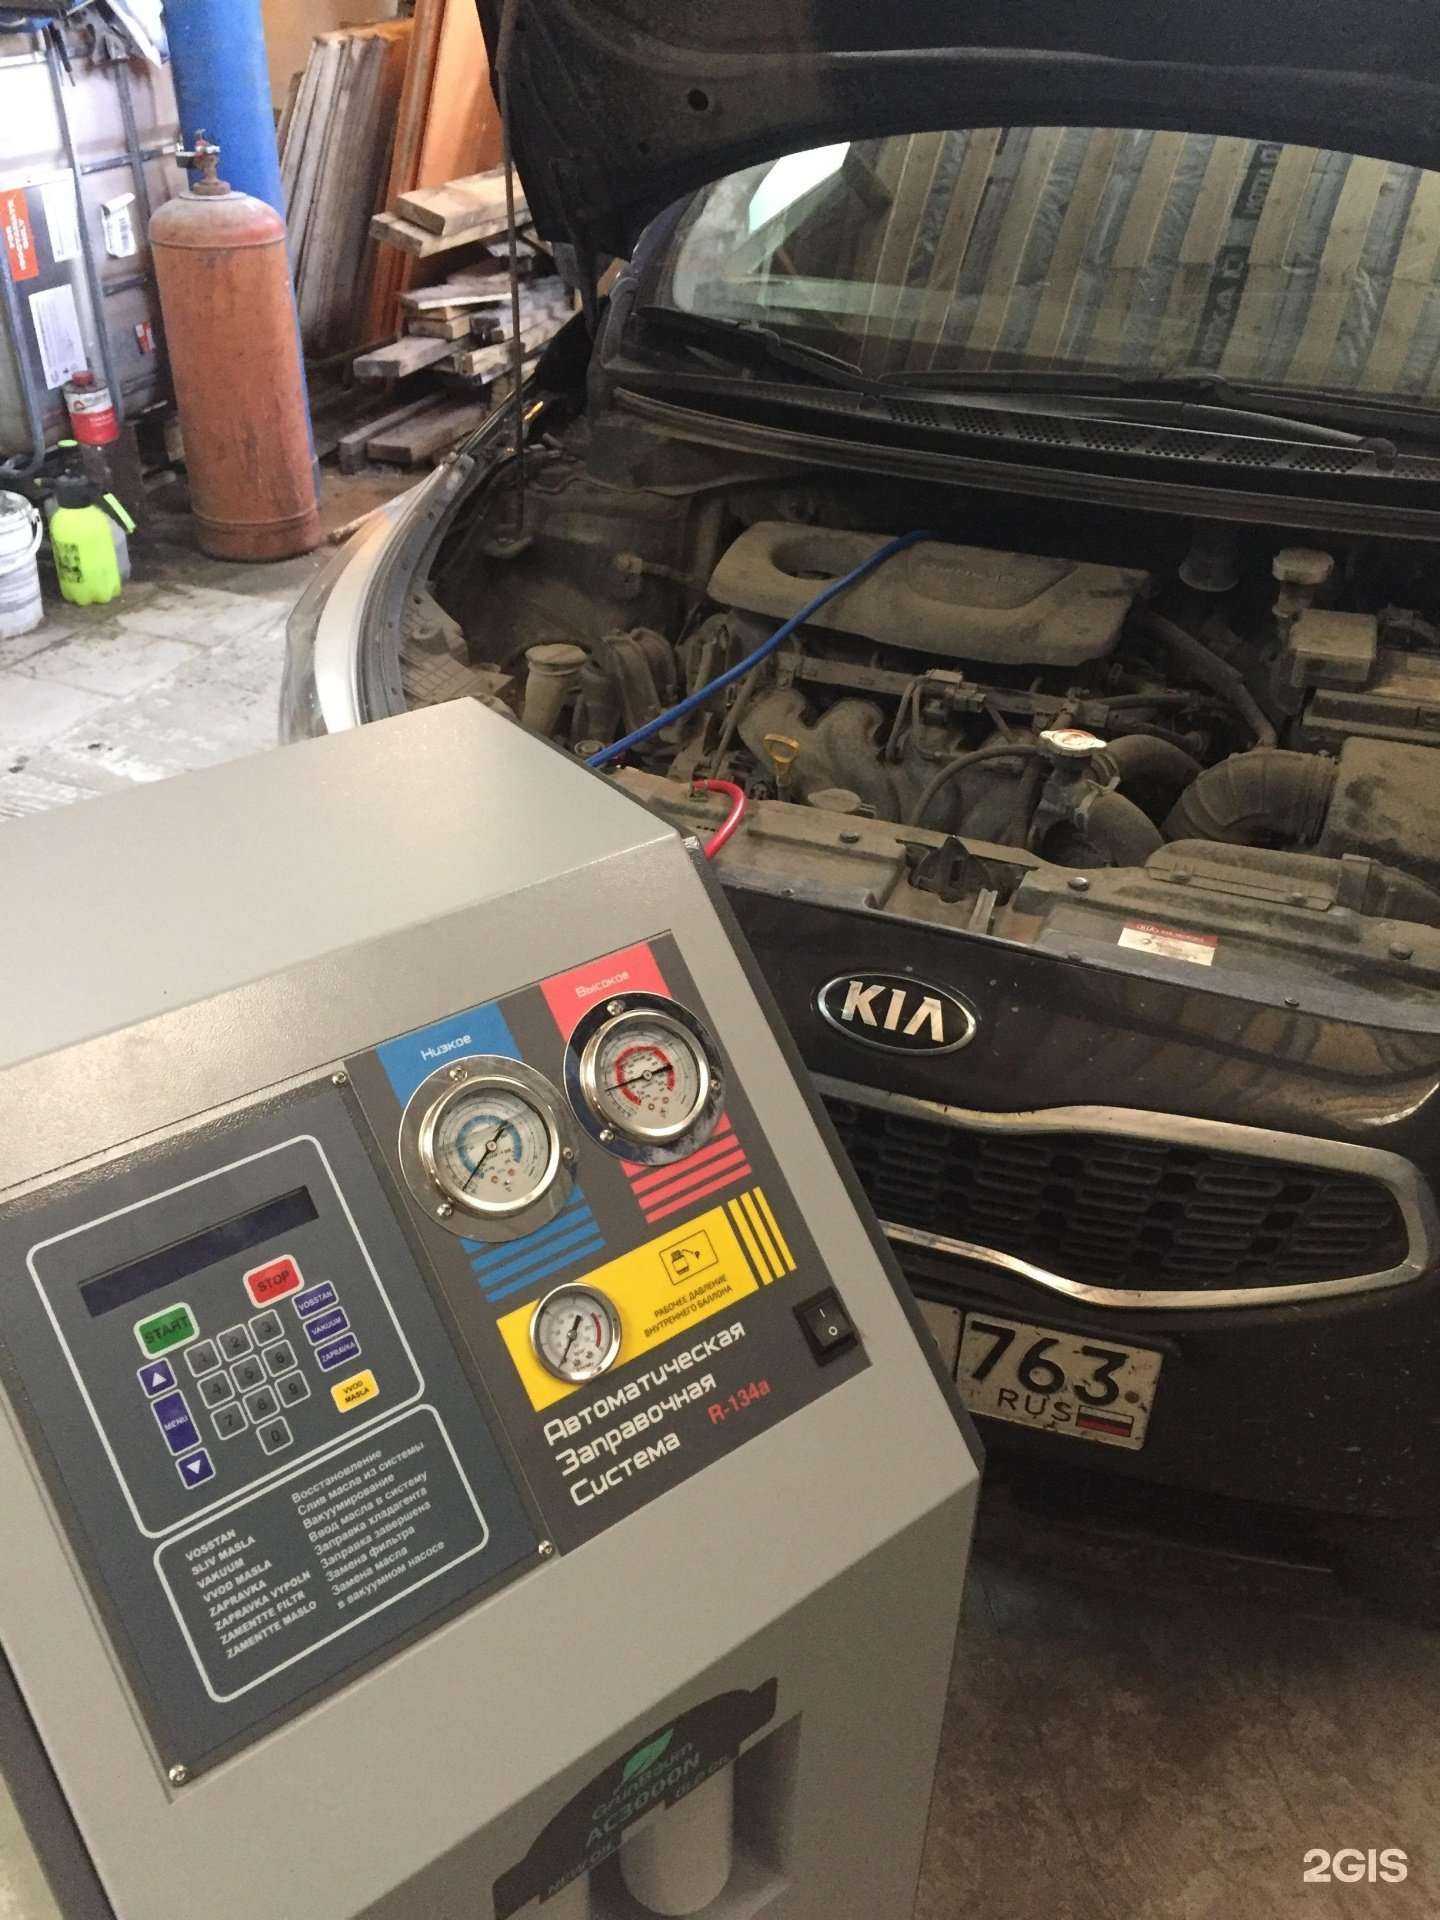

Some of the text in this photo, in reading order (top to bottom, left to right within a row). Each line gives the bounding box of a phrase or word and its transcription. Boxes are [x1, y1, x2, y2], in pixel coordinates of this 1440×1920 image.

[575, 971, 630, 998] Высокое
[841, 980, 944, 1042] KIA
[420, 1033, 472, 1061] Низкое
[256, 1268, 292, 1294] STOP
[143, 1315, 189, 1345] START
[543, 1322, 745, 1446] Автоматическая
[969, 1320, 1130, 1405] 763
[555, 1373, 716, 1476] Заправочная
[707, 1379, 771, 1425] R-134a
[998, 1387, 1071, 1422] RUS
[291, 1450, 381, 1503] Восстановление
[297, 1442, 424, 1515] Слив масла из системы
[570, 1433, 680, 1506] Система
[303, 1474, 394, 1529] Вакуумирование
[308, 1522, 340, 1542] Ввод
[340, 1503, 374, 1525] масла
[385, 1471, 427, 1499] систему
[314, 1487, 427, 1555] Заправка хладагента
[185, 1529, 236, 1561] VOSSTAN
[191, 1536, 255, 1576] SLIV MASLA
[320, 1535, 372, 1569] Заправка
[326, 1526, 415, 1582] Замена фильтра
[197, 1558, 244, 1588] VAKUUM
[203, 1560, 272, 1602] VVOD MASLA
[331, 1547, 408, 1595] Замена масла
[347, 1564, 406, 1604] вакуумном
[408, 1542, 444, 1567] насосе
[209, 1580, 267, 1617] ZAPRAVKA
[214, 1571, 311, 1631] ZAPRAVKA VYPOLN
[276, 1591, 305, 1612] FILTR
[282, 1601, 316, 1625] MASLO
